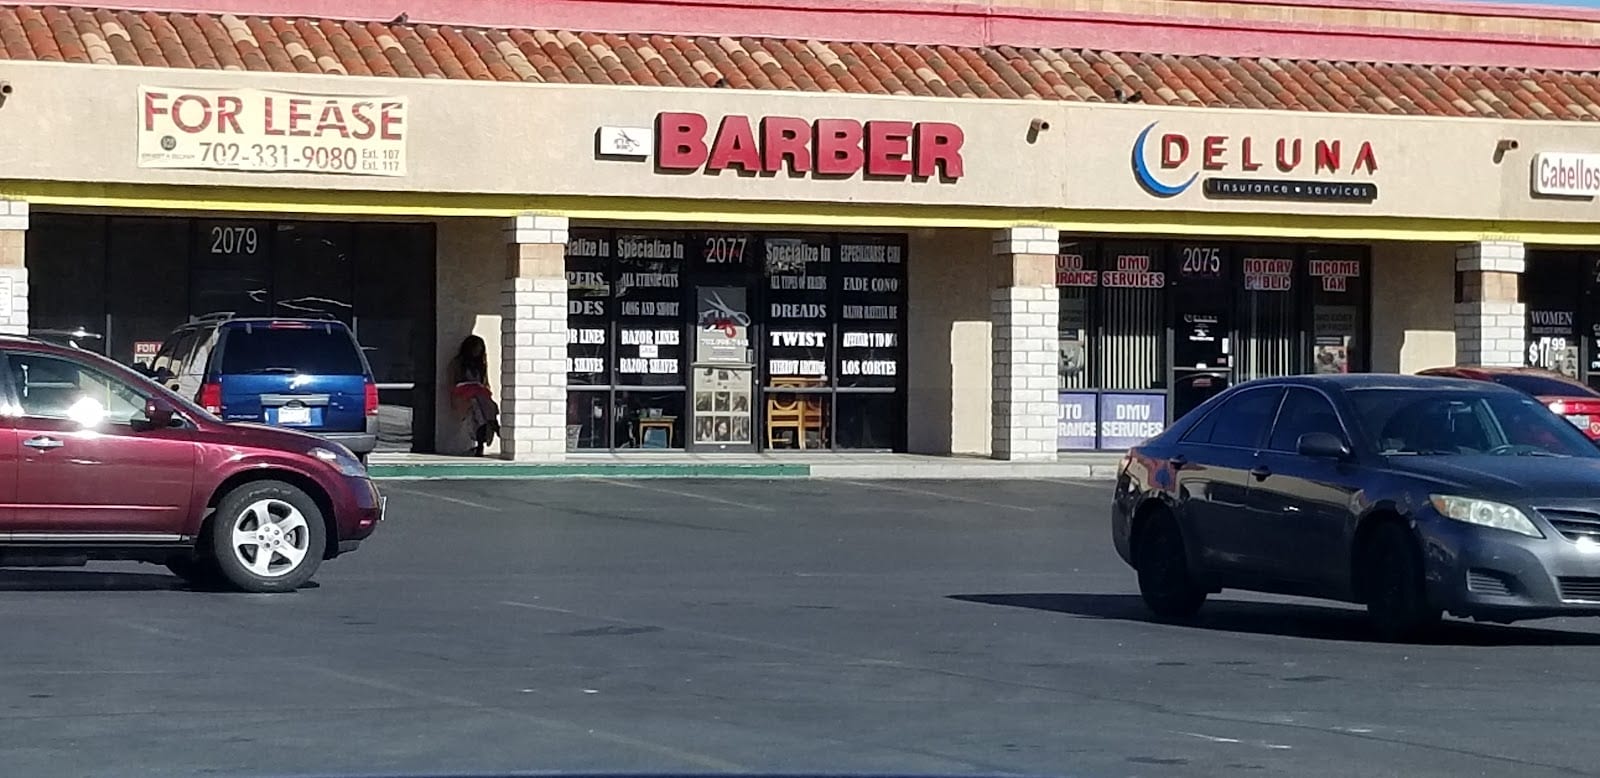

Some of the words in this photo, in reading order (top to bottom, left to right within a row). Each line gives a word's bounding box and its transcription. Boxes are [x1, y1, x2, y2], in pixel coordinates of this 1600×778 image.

[144, 91, 244, 135] FOR
[264, 97, 404, 140] LEASE
[199, 141, 358, 170] 702-331-9080
[362, 147, 380, 159] Ext.
[383, 149, 400, 160] 107
[655, 112, 964, 184] BARBER
[1161, 133, 1378, 176] DELUNA
[362, 158, 380, 171] Ext.
[382, 160, 400, 171] 117
[1541, 157, 1600, 191] Cabellos
[1217, 181, 1289, 194] insurance
[1307, 185, 1368, 197] services
[211, 226, 257, 254] 2079
[617, 239, 671, 259] Specialize
[673, 241, 684, 259] In
[706, 238, 747, 263] 2077
[766, 242, 819, 263] Specialize
[820, 245, 831, 262] In
[1118, 255, 1150, 270] DMV
[1183, 248, 1220, 273] 2075
[1243, 258, 1293, 274] NOTARY
[1309, 260, 1360, 276] INCOME
[843, 277, 869, 291] FADE
[1102, 271, 1164, 287] SERVICES
[1245, 274, 1291, 290] PUBLIC
[1322, 276, 1346, 291] TAX
[621, 301, 640, 316] LONG
[641, 301, 655, 316] AND
[771, 303, 827, 319] DREADS
[1531, 310, 1573, 325] WOMEN
[579, 328, 605, 345] LINES
[621, 330, 654, 345] RAZOR
[654, 330, 680, 345] LINES
[769, 331, 827, 348] TWIST
[620, 358, 648, 374] RAZOR
[841, 360, 860, 375] LOS
[861, 360, 897, 376] CORTES
[1116, 404, 1151, 420] DMV
[1102, 421, 1165, 438] SERVICES
